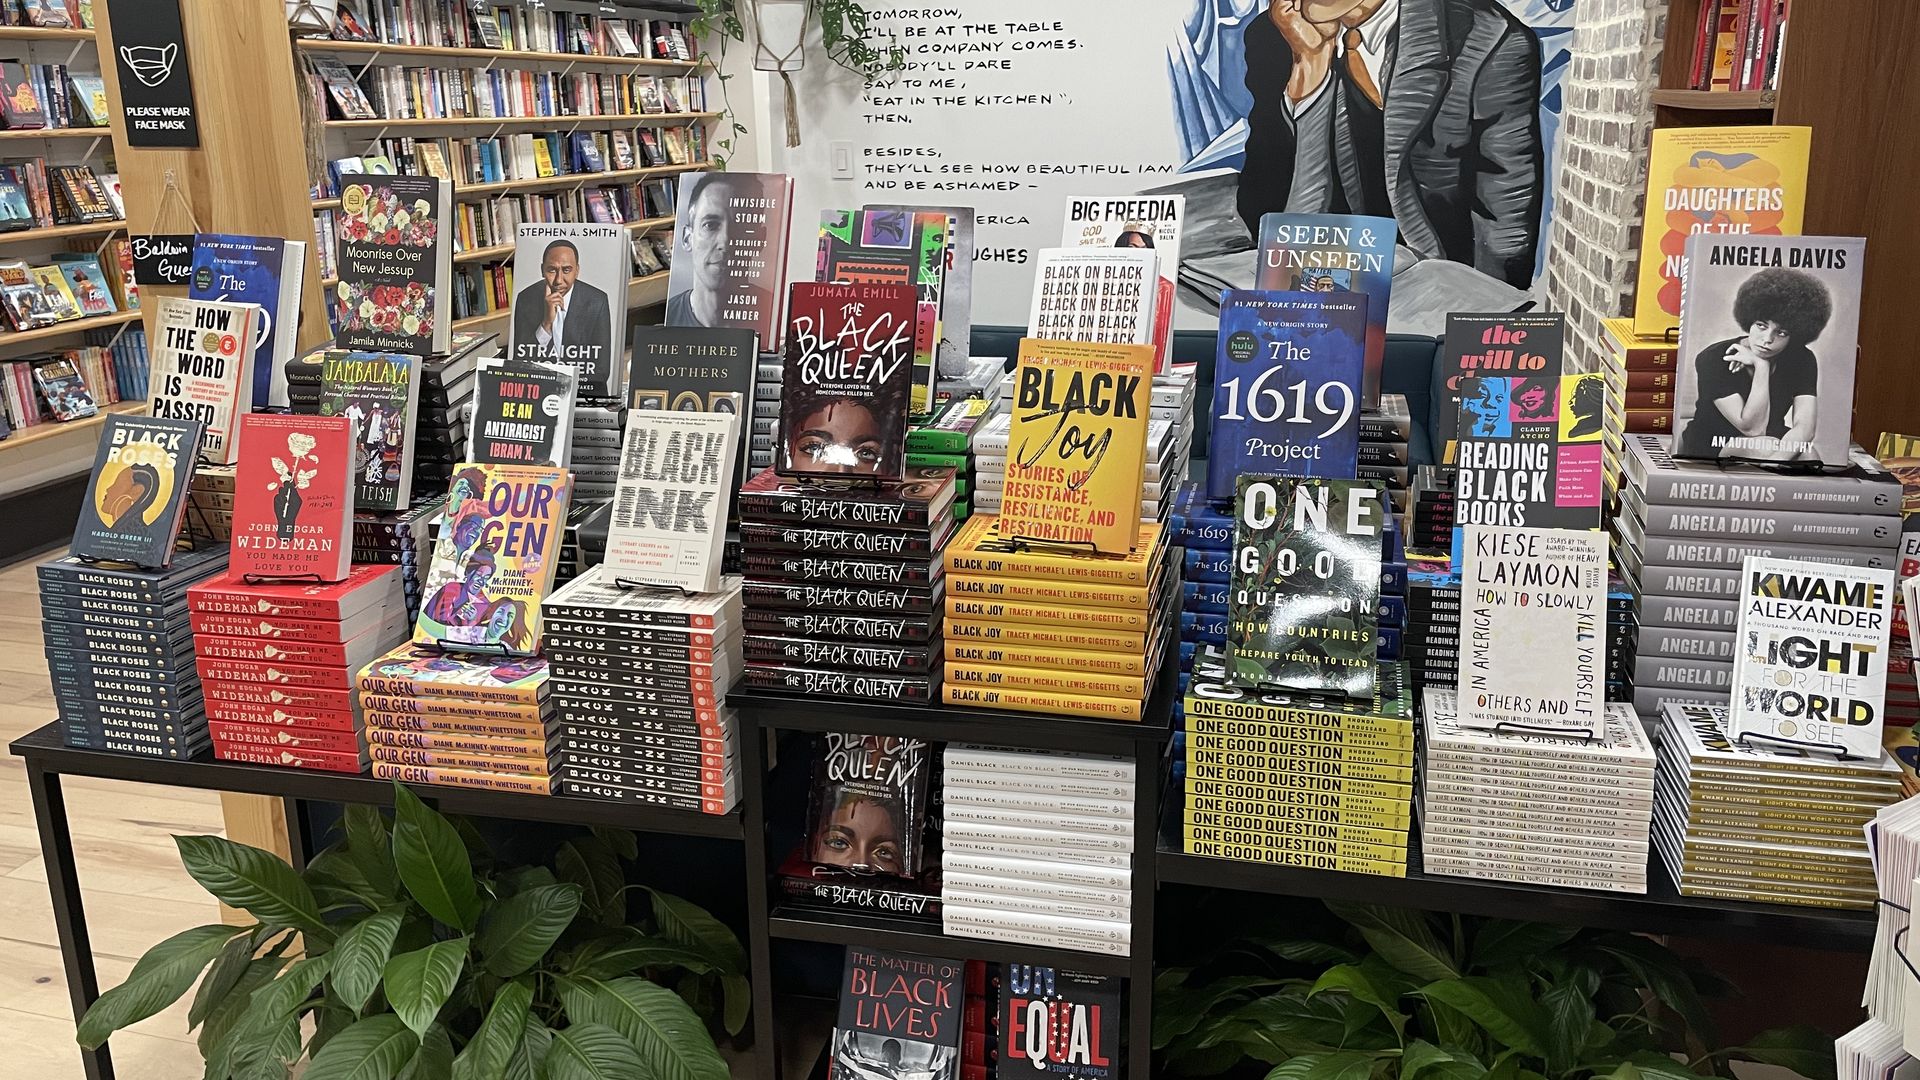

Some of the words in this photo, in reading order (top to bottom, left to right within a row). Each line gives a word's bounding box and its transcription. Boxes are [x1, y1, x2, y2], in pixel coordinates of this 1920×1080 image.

[864, 8, 962, 21] TOMORROW,
[864, 27, 895, 39] I'LL
[905, 27, 927, 37] BE
[936, 26, 954, 35] AT
[963, 24, 998, 35] THE
[1005, 22, 1063, 32] TABLE
[918, 42, 1004, 54] COMPANY
[1012, 40, 1084, 50] COMES.
[863, 61, 956, 72] NOBODY'LL
[965, 60, 1011, 70] DARE
[864, 80, 895, 89] SAY
[902, 79, 922, 88] TO
[911, 97, 924, 105] IN
[932, 96, 967, 105] THE
[127, 107, 161, 116] PLEASE
[162, 108, 190, 116] WEAR
[864, 115, 912, 124] THEN.
[135, 121, 158, 129] FACE
[160, 121, 186, 130] MASK
[864, 148, 941, 157] BESIDES,
[865, 164, 933, 173] THEY'LL
[940, 165, 974, 173] SEE
[982, 165, 1019, 173] HOW
[1027, 165, 1130, 174] BEAUTIFUL
[865, 181, 896, 189] AND
[904, 180, 926, 189] BE
[933, 181, 1020, 191] ASHAMED
[729, 198, 776, 208] INVISIBLE
[1664, 188, 1784, 212] DAUGHTERS
[736, 213, 766, 223] STORM
[1072, 201, 1099, 221] BIG
[1105, 200, 1176, 222] FREEDIA
[520, 228, 566, 237] STEPHEN
[570, 228, 579, 236] A.
[583, 229, 617, 238] SMITH
[1277, 225, 1352, 247] SEEN
[1359, 228, 1376, 247] &
[132, 238, 188, 259] Baldwin
[346, 246, 392, 260] Moonrise
[396, 249, 422, 261] Over
[1710, 246, 1782, 267] ANGELA
[1789, 247, 1847, 270] DAVIS
[353, 262, 376, 273] New
[379, 263, 414, 278] Jessup
[1267, 250, 1384, 272] UNSEEN
[1045, 266, 1080, 279] BLACK
[1085, 266, 1100, 279] ON
[1104, 266, 1143, 279] BLACK
[728, 295, 757, 305] JASON
[810, 288, 856, 298] JUMATA
[863, 288, 899, 299] EMILL
[195, 307, 231, 331] HOW
[724, 310, 759, 320] KANDER
[840, 302, 865, 320] THE
[167, 327, 196, 351] THE
[349, 336, 374, 346] Jamila
[377, 337, 414, 349] Minnicks
[792, 308, 910, 366] BLACK
[1481, 325, 1528, 345] the
[517, 344, 602, 359] STRAIGHT
[648, 344, 679, 355] THE
[686, 345, 738, 357] THREE
[1268, 341, 1310, 361] The
[1460, 350, 1513, 369] will
[1518, 353, 1546, 370] to
[178, 353, 225, 379] WORD
[326, 360, 408, 384] JAMBALAYA
[653, 366, 729, 378] MOTHERS
[802, 347, 907, 385] QUEEN
[165, 375, 181, 396] IS
[500, 382, 524, 398] HOW
[527, 385, 539, 399] TO
[1018, 367, 1140, 419] BLACK
[153, 398, 215, 425] PASSED
[502, 402, 515, 417] BE
[517, 404, 533, 419] AN
[1219, 365, 1354, 439] 1619
[112, 429, 183, 450] BLACK
[485, 421, 546, 440] ANTIRACIST
[490, 442, 522, 459] IBRAM
[525, 446, 534, 460] X.
[1017, 403, 1112, 491] Joy
[1246, 438, 1321, 462] Project
[1711, 435, 1727, 448] AN
[1727, 436, 1814, 453] AUTOBIOGRAPHY
[107, 447, 177, 469] ROSES
[1460, 442, 1549, 471] READING
[1008, 463, 1064, 482] STORIES
[362, 486, 393, 501] TEISH
[1006, 482, 1092, 506] RESISTANCE,
[1458, 469, 1548, 502] BLACK
[488, 482, 553, 519] OUR
[1244, 482, 1377, 536] ONE
[1003, 501, 1083, 524] RESILIENCE,
[1087, 511, 1115, 526] AND
[1457, 500, 1526, 527] BOOKS
[249, 523, 278, 532] JOHN
[286, 525, 323, 534] EDGAR
[1001, 519, 1093, 542] RESTORATION
[238, 536, 332, 551] WIDEMAN
[480, 521, 548, 557] GEN
[1476, 532, 1540, 558] KIESE
[492, 578, 534, 587] McKINNEY-
[502, 569, 526, 578] DIANE
[1478, 562, 1580, 589] LAYMON
[488, 586, 533, 596] WHETSTONE
[1476, 589, 1507, 606] HOW
[1514, 592, 1529, 606] TO
[1537, 594, 1594, 610] SLOWLY
[1752, 572, 1884, 610] KWAME
[1749, 600, 1882, 630] ALEXANDER
[1235, 622, 1269, 633] HOW
[1276, 626, 1369, 642] COUNTRIES
[1576, 613, 1596, 642] KILL
[1472, 608, 1492, 669] AMERICA
[1234, 649, 1279, 660] PREPARE
[1285, 653, 1318, 663] YOUTH
[1325, 656, 1337, 665] TO
[1342, 658, 1368, 668] LEAD
[1745, 631, 1877, 677] LIGHT
[1472, 675, 1487, 690] IN
[1575, 647, 1594, 716] YOURSELF
[1478, 694, 1531, 712] OTHERS
[1538, 700, 1568, 714] AND
[1743, 686, 1874, 726] WORLD
[1194, 701, 1221, 715] ONE
[1224, 704, 1264, 719] GOOD
[1268, 709, 1341, 728] QUESTION
[851, 952, 876, 966] THE
[881, 957, 934, 975] MATTER
[940, 966, 960, 979] OF
[851, 968, 952, 1009] BLACK
[856, 1000, 942, 1038] LIVES
[1008, 999, 1110, 1070] EQUAL
